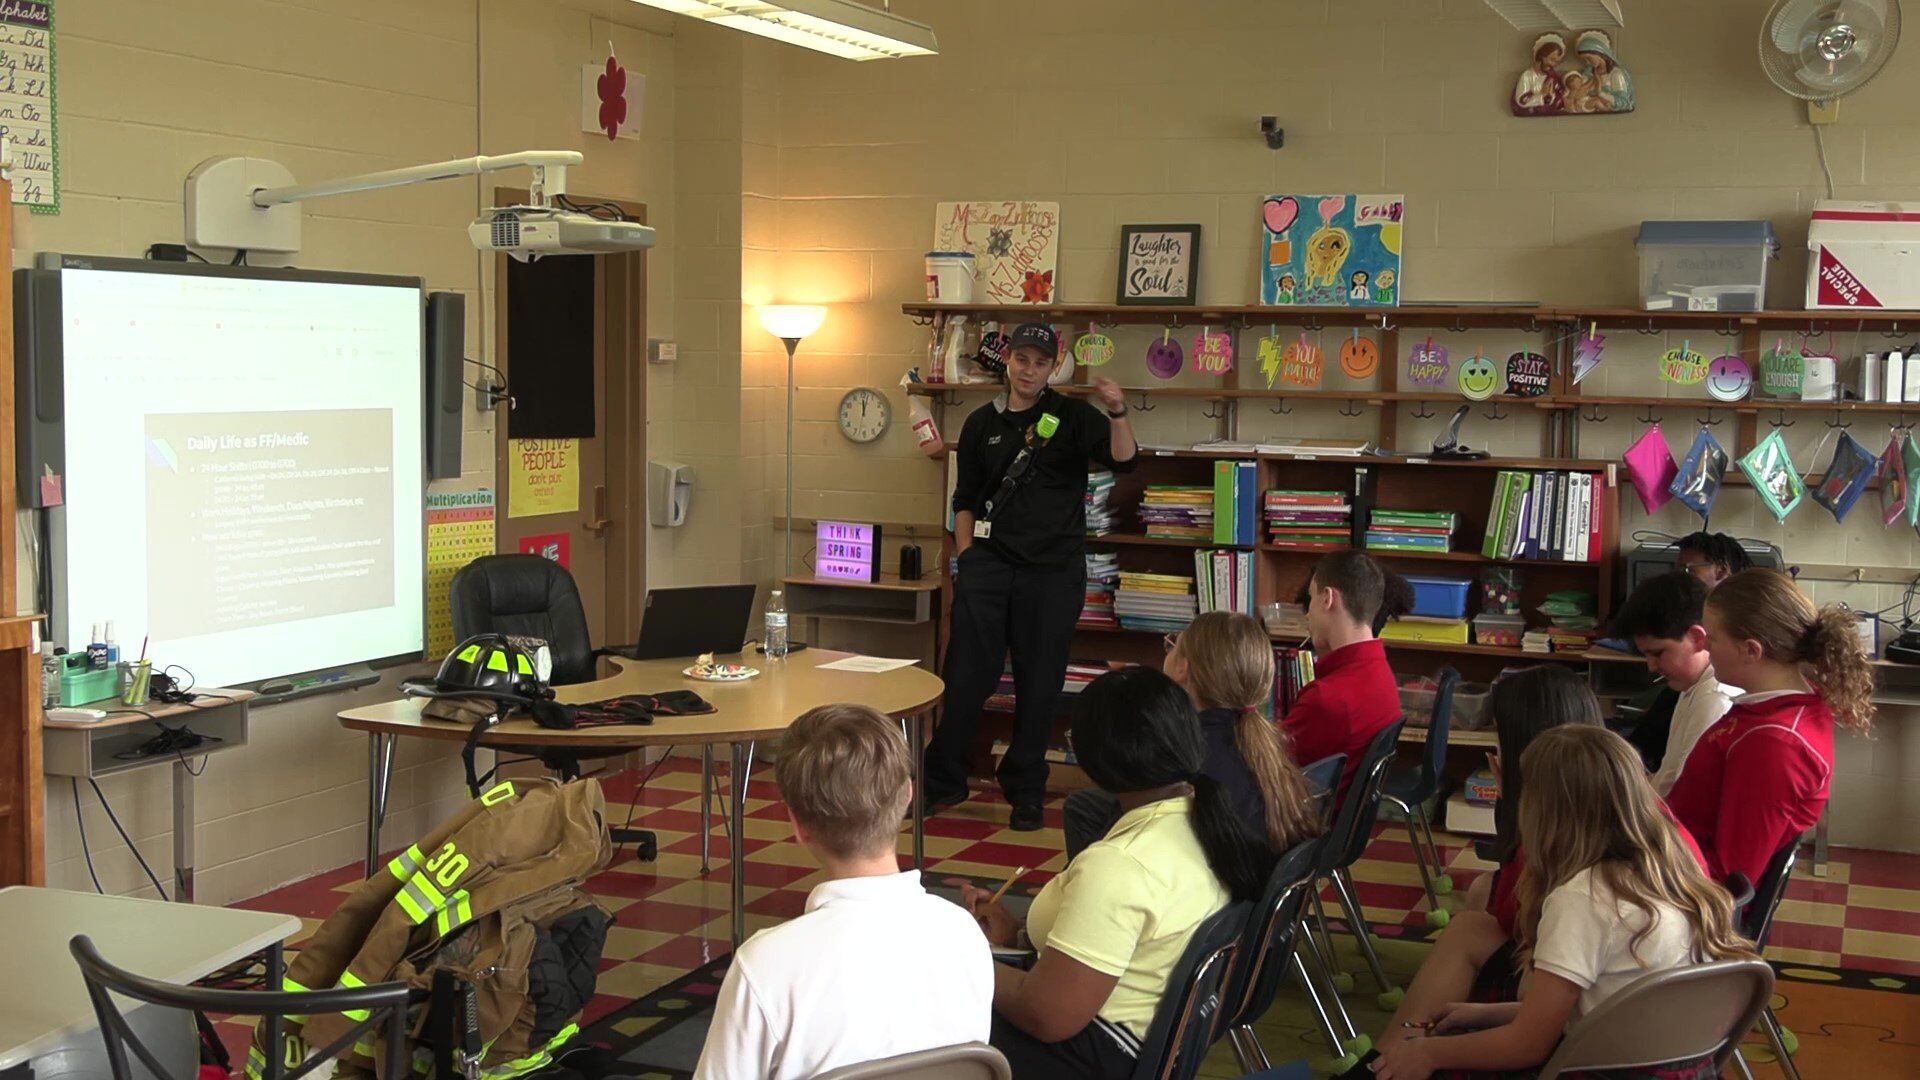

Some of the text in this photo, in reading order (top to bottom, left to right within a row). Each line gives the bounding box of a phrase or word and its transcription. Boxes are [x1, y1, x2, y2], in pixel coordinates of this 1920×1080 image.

[20, 30, 45, 49] Dd
[23, 54, 45, 73] Hh
[23, 80, 45, 97] Ll
[21, 104, 41, 121] Oo
[28, 130, 46, 147] Ss
[23, 152, 51, 171] Ww
[1130, 234, 1181, 257] Laughter
[1143, 257, 1156, 266] good
[1159, 256, 1168, 265] for
[1129, 267, 1173, 296] Soul
[1820, 266, 1858, 305] SPECIAL
[1830, 264, 1862, 294] VALUE
[1204, 337, 1219, 353] BE
[1198, 354, 1226, 371] YOU
[1296, 344, 1316, 364] YOU
[1419, 351, 1436, 363] BE
[1667, 351, 1701, 365] CHOOSE
[1410, 364, 1445, 378] HAPPY
[1516, 358, 1542, 374] STAY
[1784, 357, 1801, 371] ARE
[1509, 373, 1548, 387] POSITIVE
[1765, 372, 1799, 388] ENOUGH
[187, 432, 310, 453] Daily Life as FF/Medic
[517, 439, 571, 452] POSITIVE
[522, 451, 566, 471] PEOPLE
[426, 492, 493, 508] Multiplication
[1580, 500, 1590, 535] Geometry
[830, 526, 861, 540] THINK
[828, 544, 861, 559] SPRING
[426, 842, 469, 887] 30
